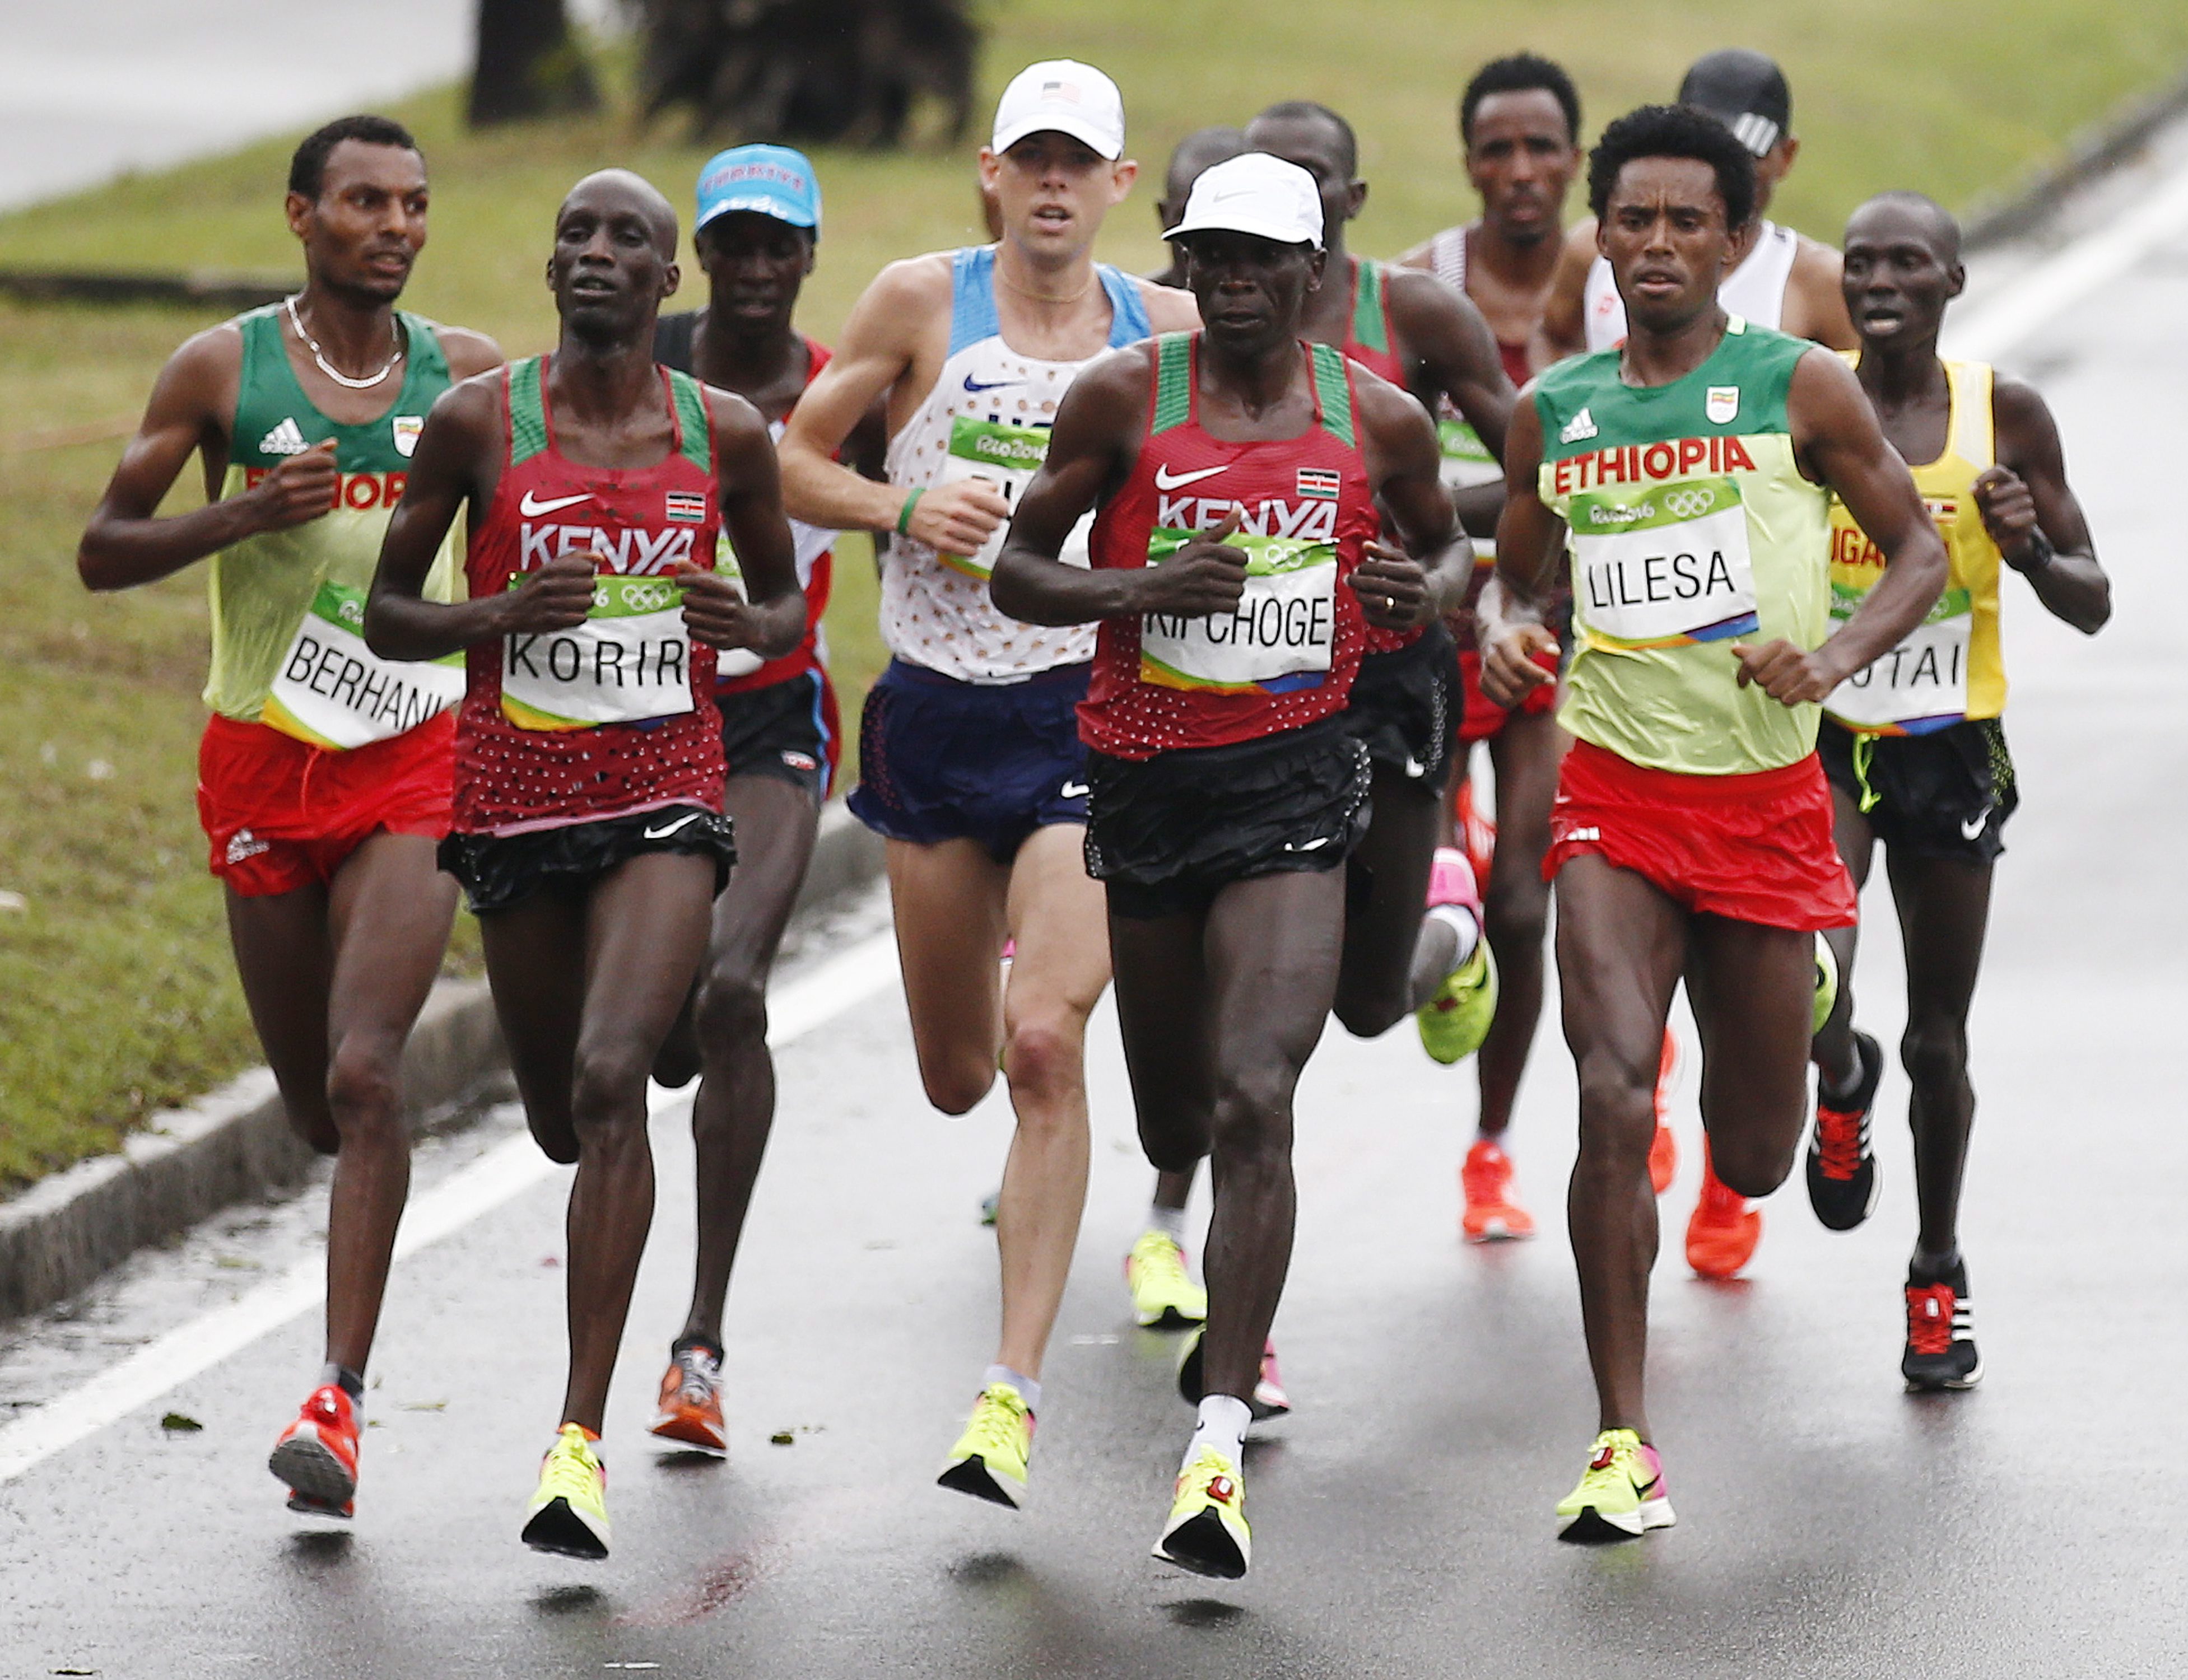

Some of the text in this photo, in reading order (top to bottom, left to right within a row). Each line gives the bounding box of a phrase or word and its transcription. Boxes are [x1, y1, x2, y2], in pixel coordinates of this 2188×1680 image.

[1555, 436, 1757, 494] ETHIOPIA
[1158, 494, 1340, 540] KENYA
[520, 522, 696, 576] KENYA
[1589, 550, 1735, 608] LILESA
[508, 633, 685, 687] KORIR
